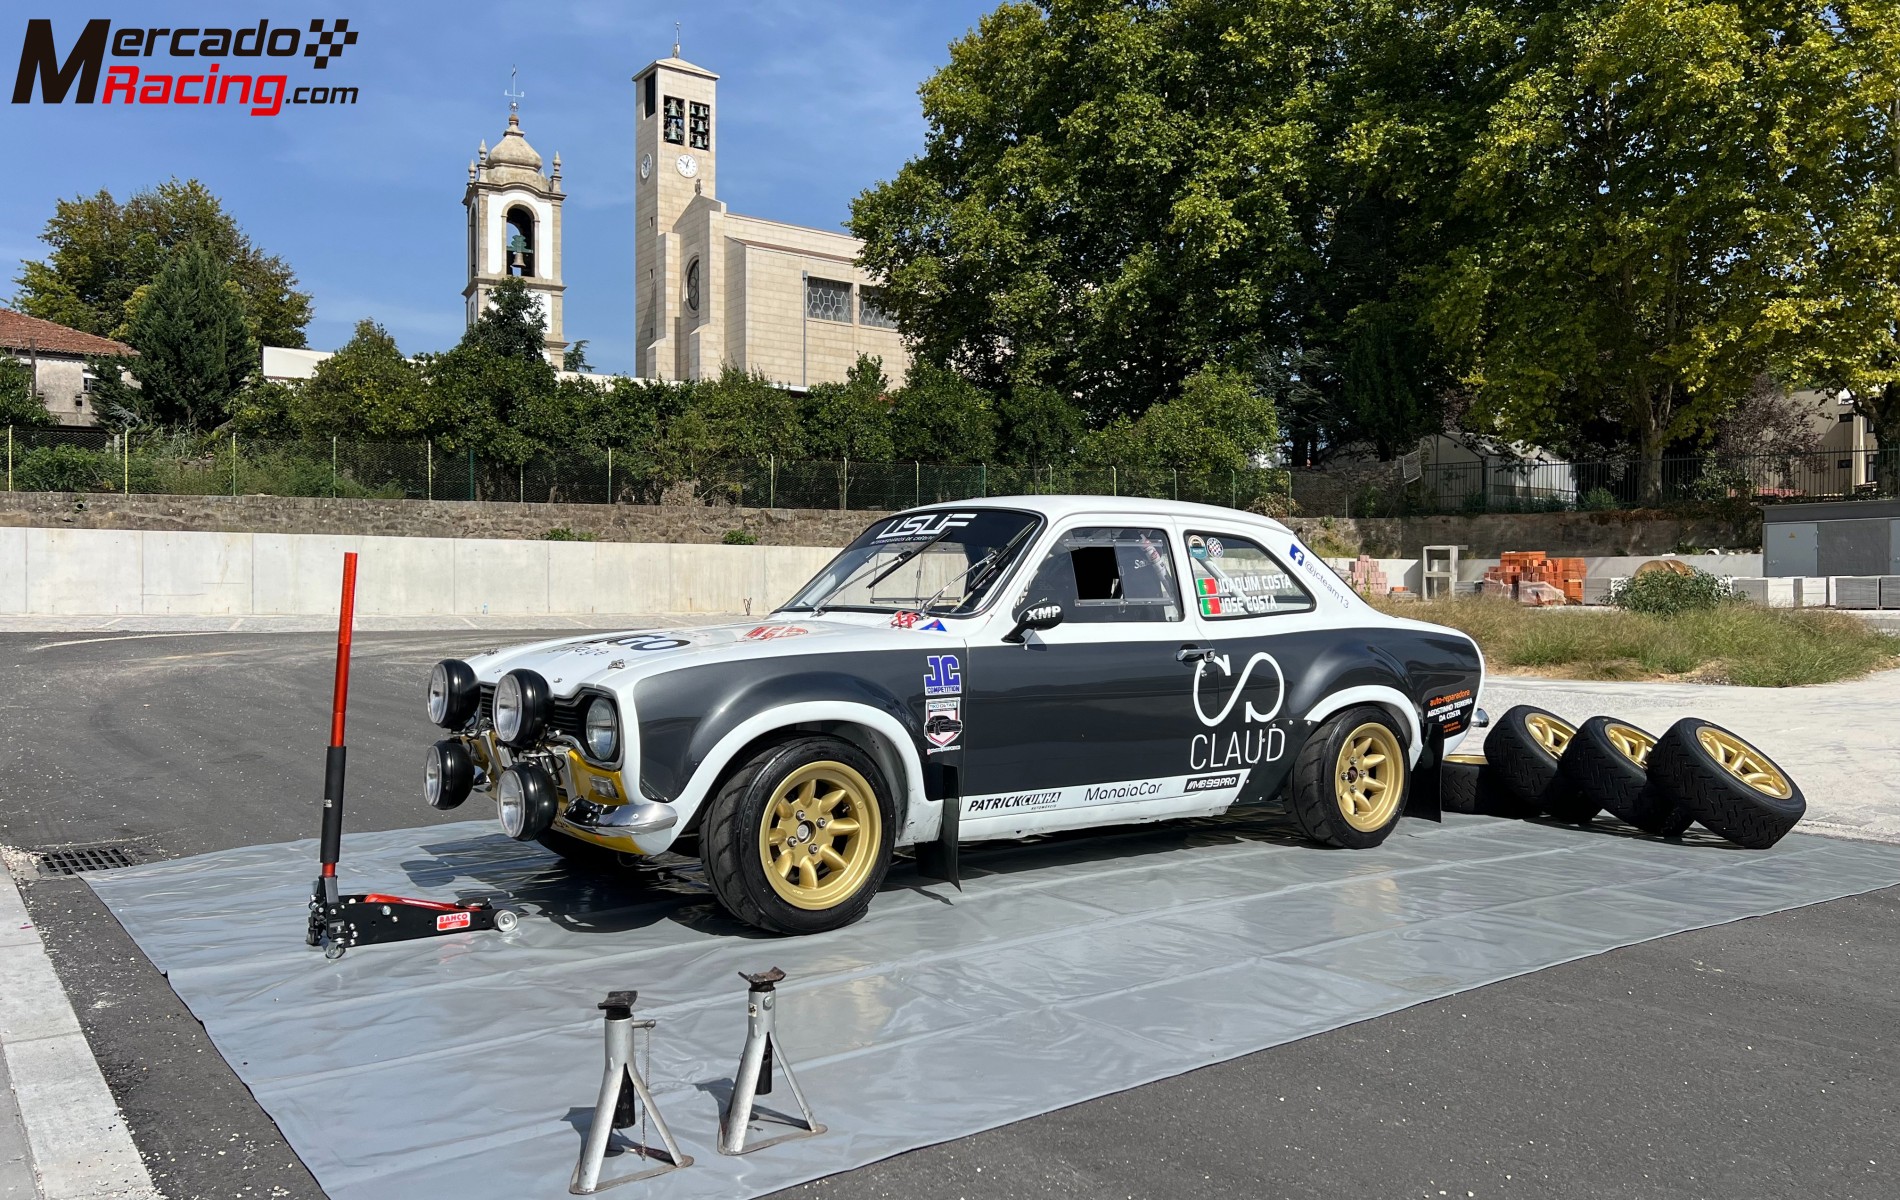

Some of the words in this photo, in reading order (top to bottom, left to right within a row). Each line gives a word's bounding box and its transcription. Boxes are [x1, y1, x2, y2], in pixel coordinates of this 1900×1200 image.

[1218, 576, 1261, 594] JOAQUIM
[1261, 573, 1293, 590] COSTA
[1305, 561, 1350, 609] @jcteam13
[1026, 605, 1061, 621] XMP
[1245, 594, 1278, 613] COSTA
[924, 655, 961, 687] JC
[926, 686, 961, 694] COMPETITION
[1427, 703, 1454, 717] AGOSTINHO
[1439, 714, 1446, 722] DA
[1446, 709, 1461, 719] COSTA
[1190, 728, 1285, 770] CLAUD
[1084, 781, 1163, 801] ManaiaCar
[439, 913, 468, 922] BAHCO
